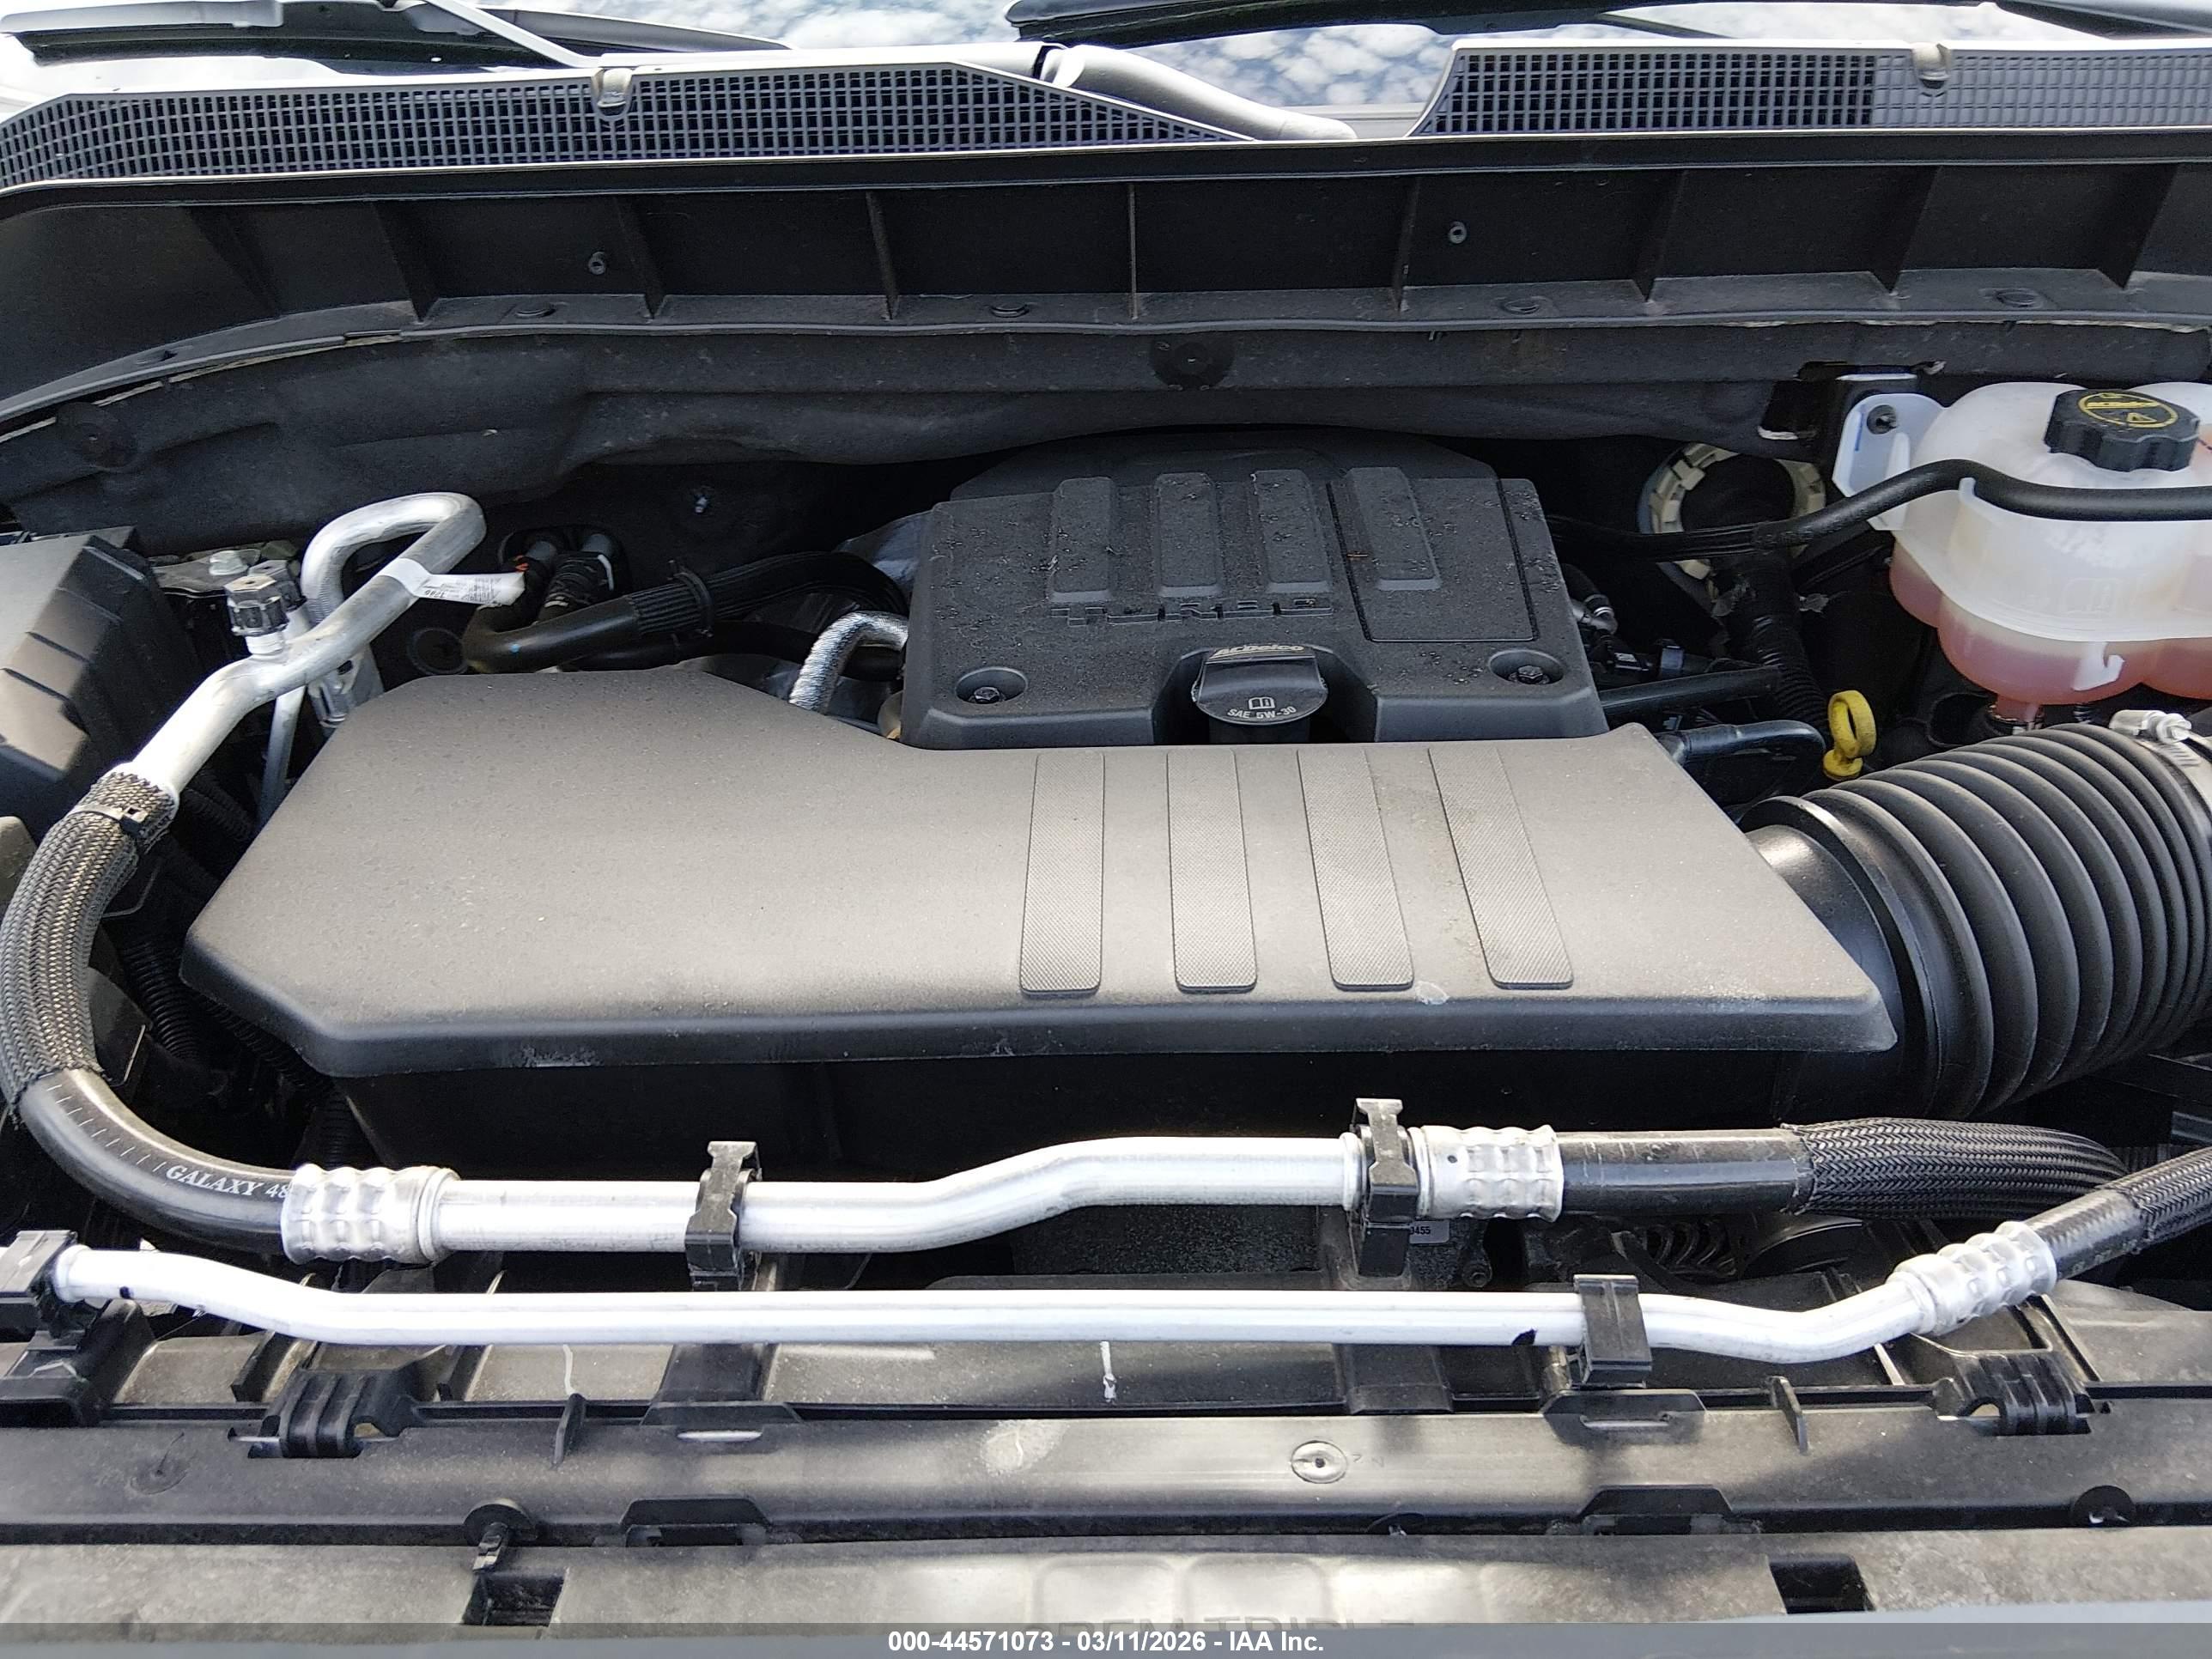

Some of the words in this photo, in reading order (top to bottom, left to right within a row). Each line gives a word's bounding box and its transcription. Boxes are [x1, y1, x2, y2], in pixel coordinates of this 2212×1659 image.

[1050, 598, 1333, 626] TURBO
[1209, 644, 1304, 659] ACDelco
[1227, 708, 1251, 719] SAE
[1256, 706, 1297, 719] 5W-30
[166, 1164, 264, 1196] GALAXY
